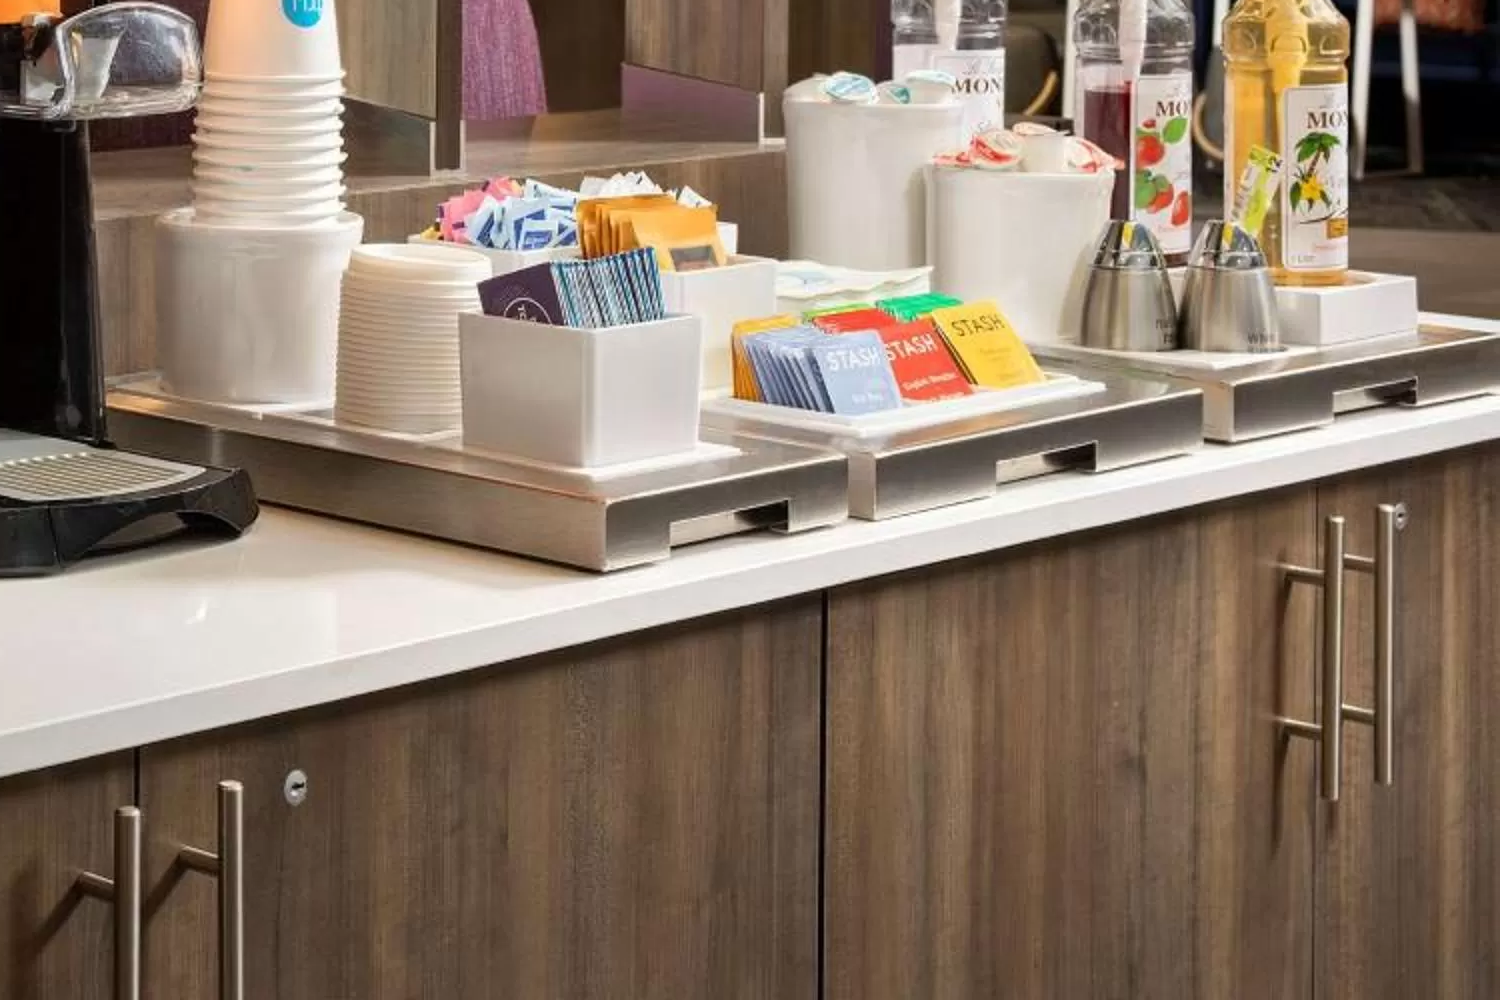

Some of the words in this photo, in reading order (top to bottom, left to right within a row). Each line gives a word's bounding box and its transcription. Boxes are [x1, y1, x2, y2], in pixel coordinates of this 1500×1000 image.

[950, 312, 1006, 337] STASH
[825, 345, 881, 372] STASH
[884, 332, 938, 362] STASH
